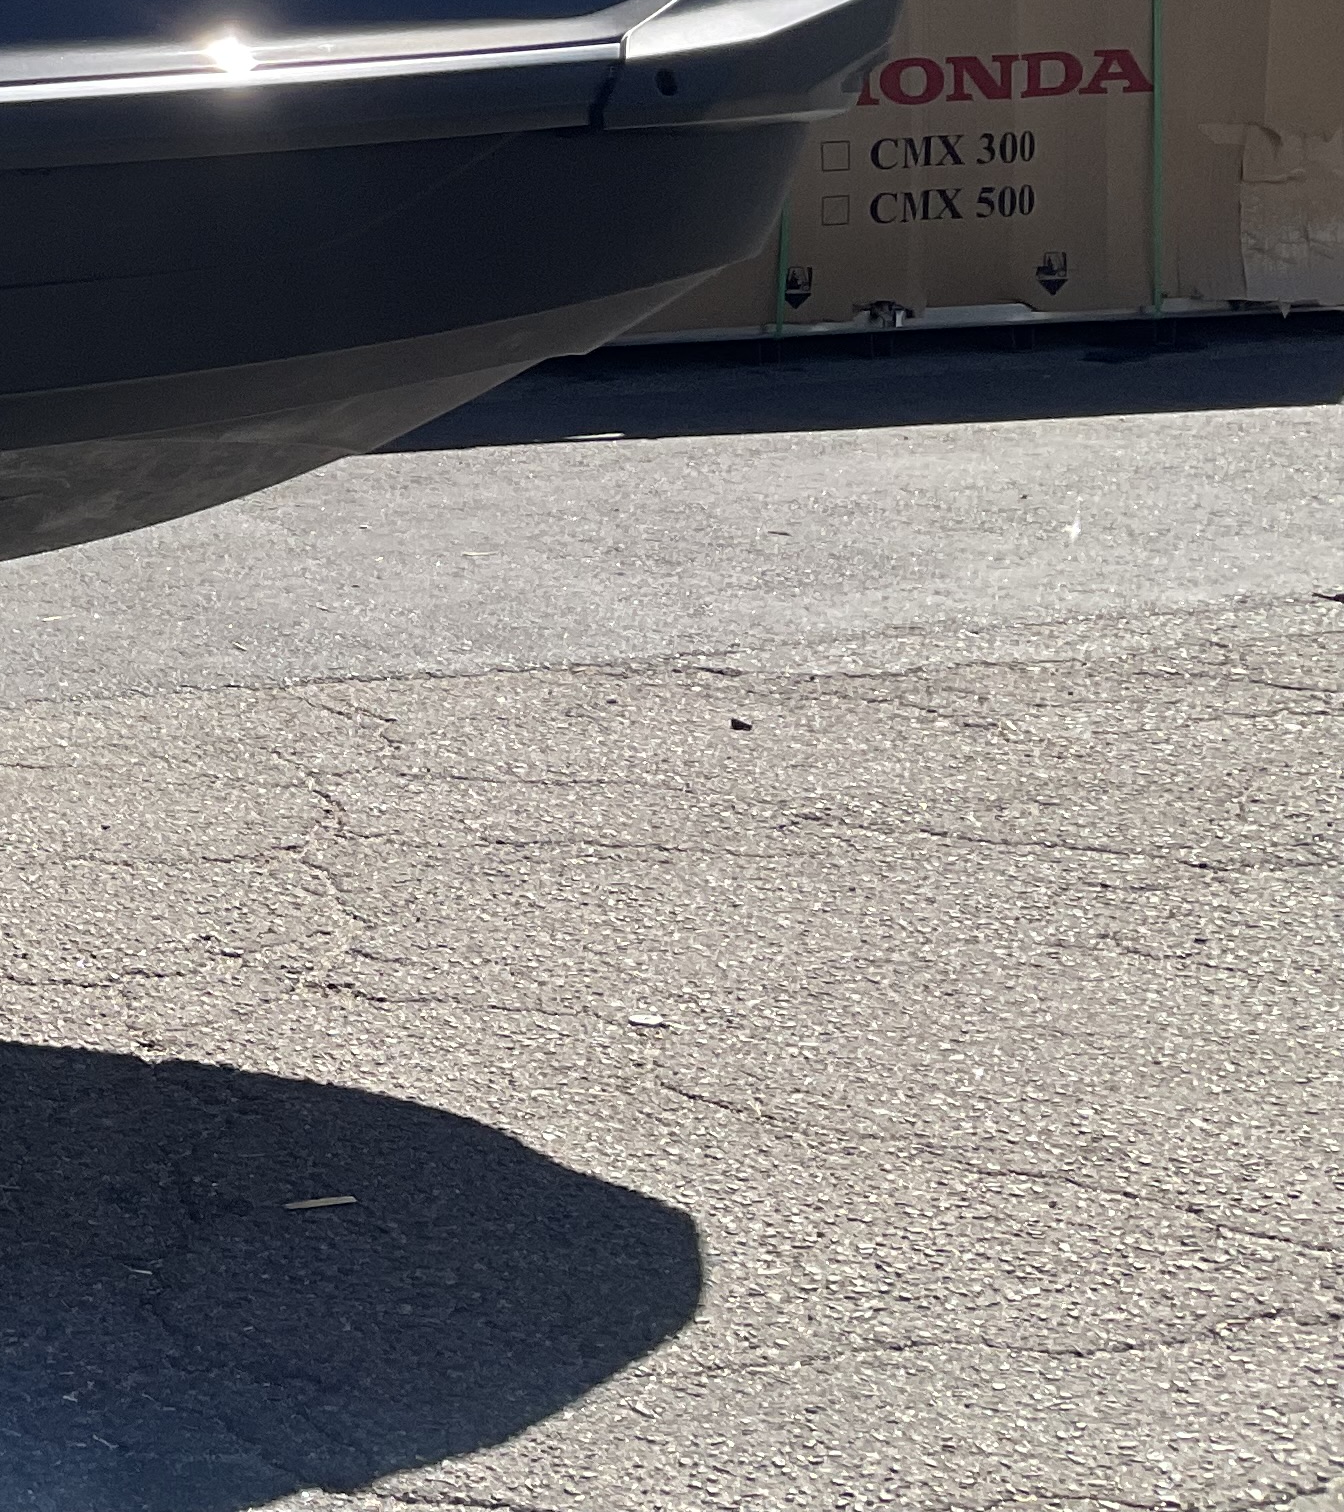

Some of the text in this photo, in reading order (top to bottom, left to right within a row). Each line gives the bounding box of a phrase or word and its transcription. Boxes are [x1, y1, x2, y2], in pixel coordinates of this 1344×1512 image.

[870, 130, 1036, 170] CMX 300
[869, 184, 1036, 224] CMX 500
